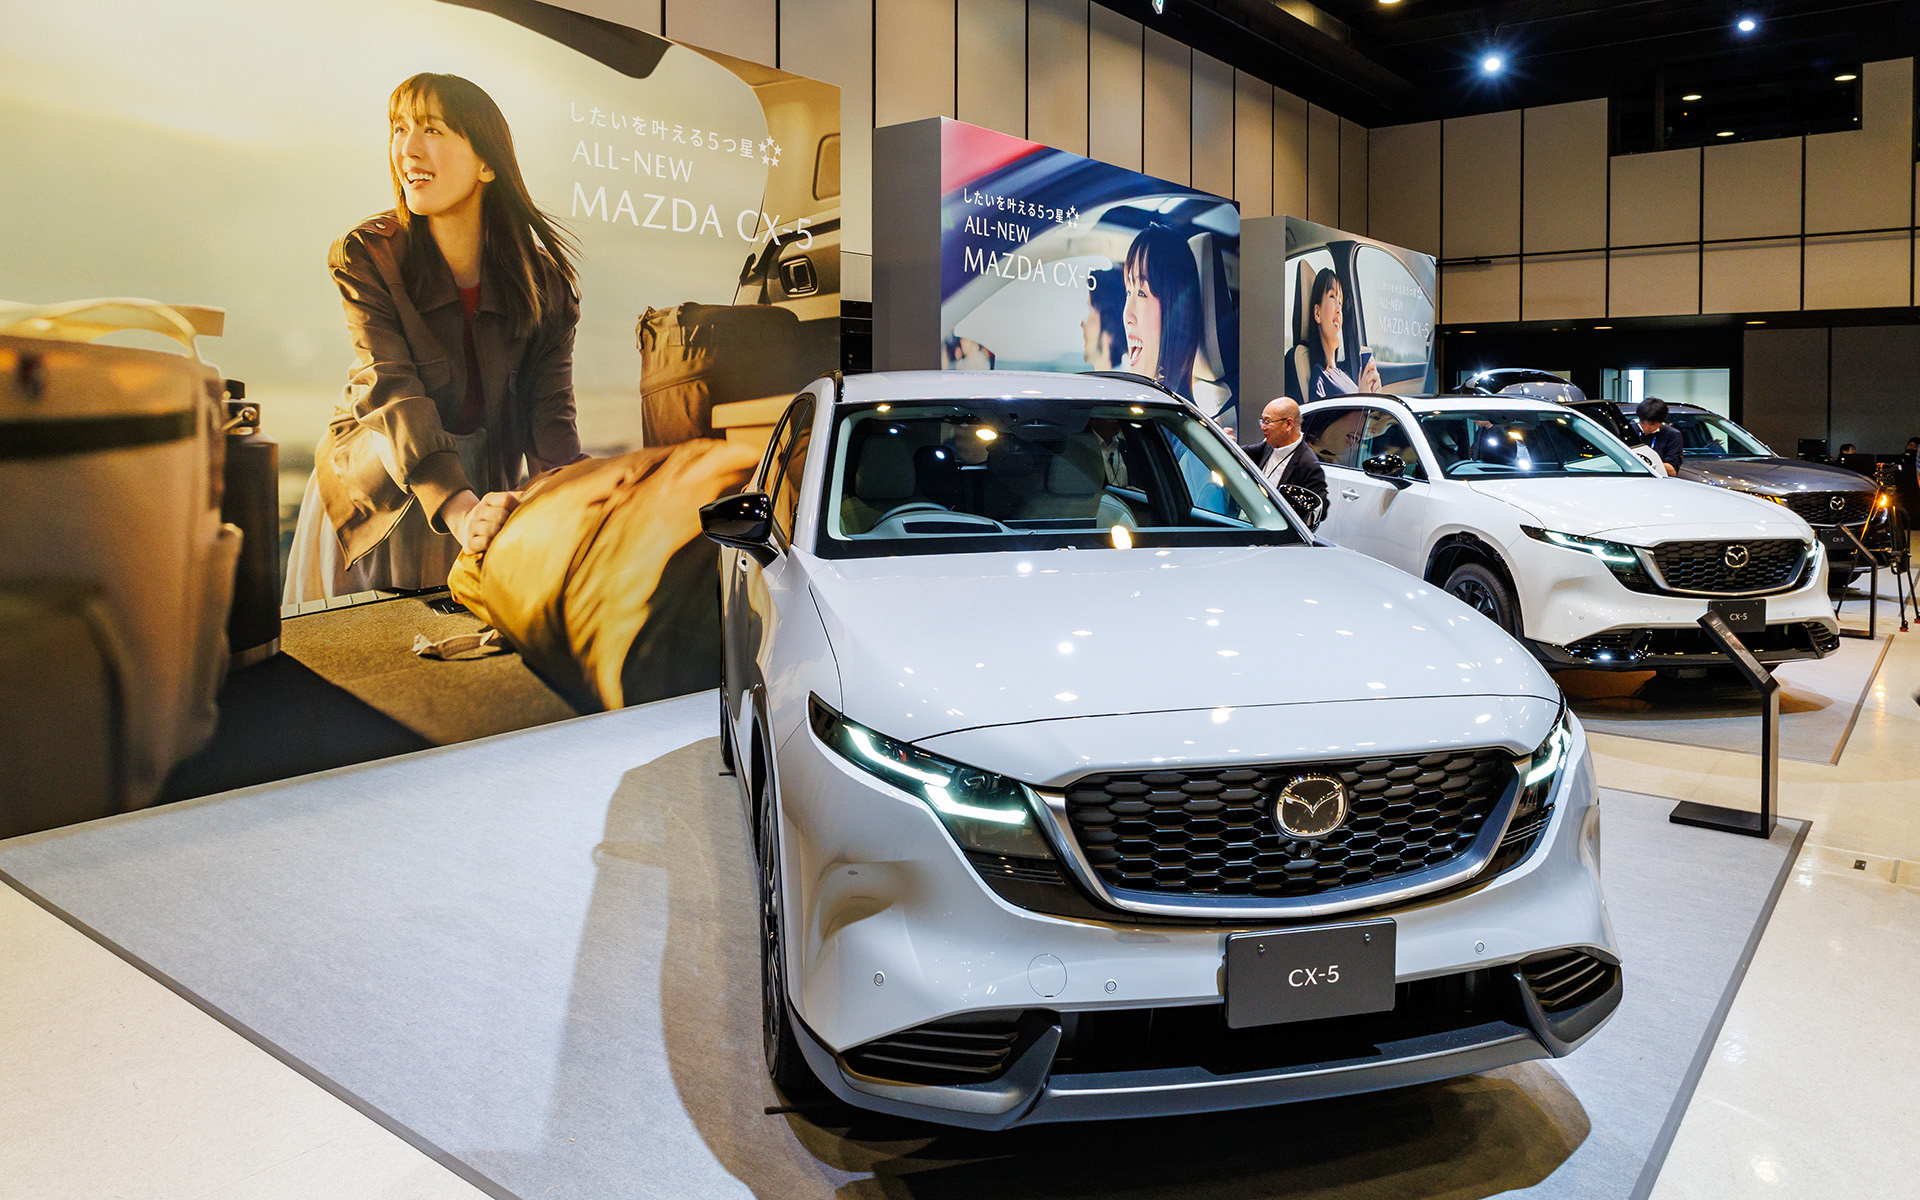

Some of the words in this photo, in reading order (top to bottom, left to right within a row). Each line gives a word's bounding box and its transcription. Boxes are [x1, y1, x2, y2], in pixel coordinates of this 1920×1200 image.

[571, 102, 754, 159] したいを叶える5つ星
[572, 139, 693, 183] ALL-NEW
[571, 182, 723, 238] MAZDA
[737, 209, 813, 250] CX-5
[963, 188, 1064, 224] したいを叶える5つ星
[964, 215, 1030, 244] ALL-NEW
[964, 245, 1046, 284] MAZDA
[1053, 261, 1097, 291] CX-5
[1378, 314, 1410, 336] MAZDA
[1411, 320, 1429, 339] CX-5
[1729, 612, 1748, 621] CX-5
[1288, 965, 1340, 987] CX-5
